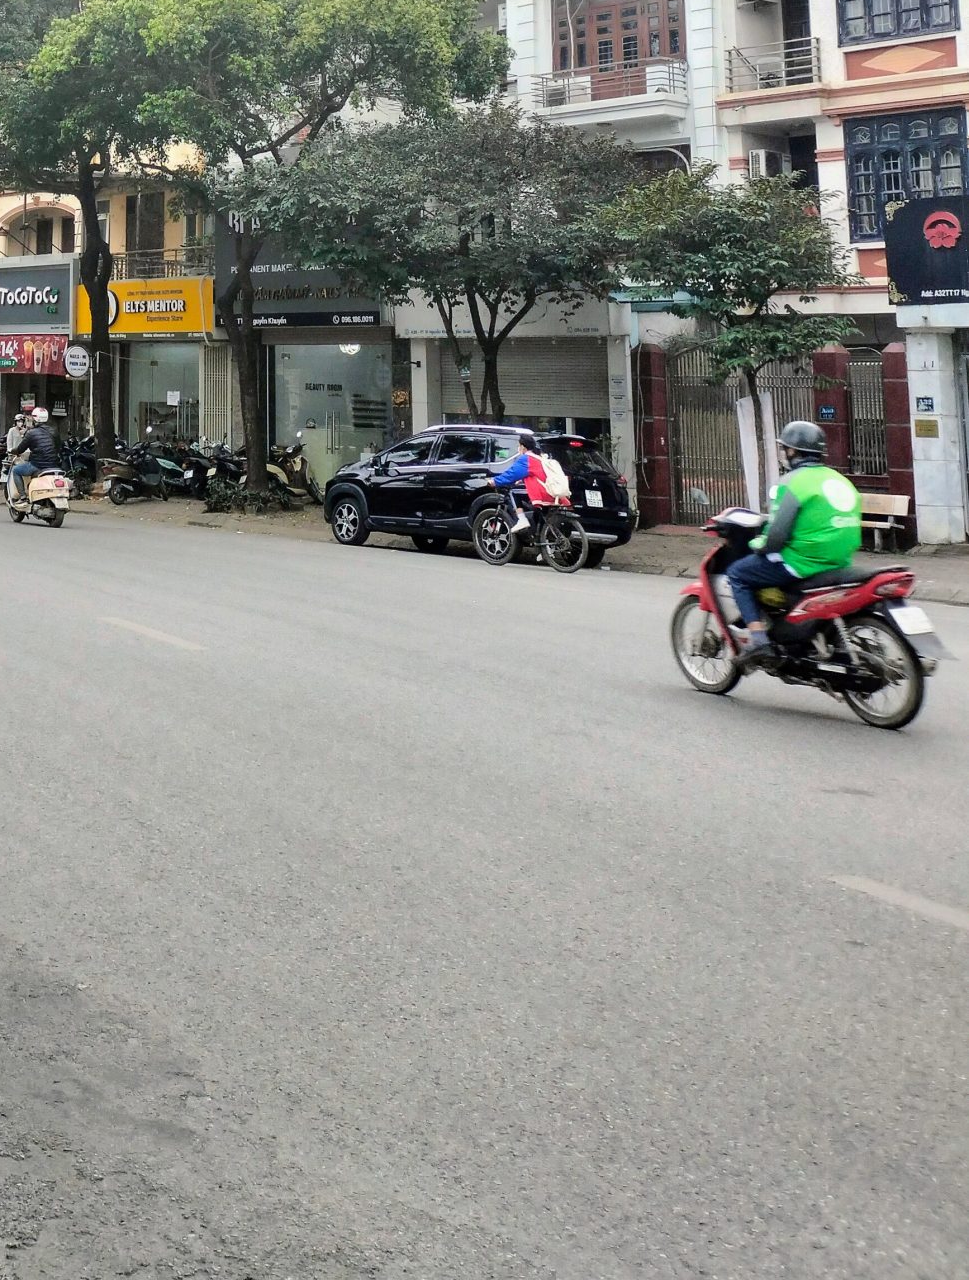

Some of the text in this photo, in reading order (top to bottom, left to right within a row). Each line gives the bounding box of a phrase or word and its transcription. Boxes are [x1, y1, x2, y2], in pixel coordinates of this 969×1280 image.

[123, 299, 185, 313] IELTS MENTOR
[305, 382, 343, 392] BEAUTY ROOM
